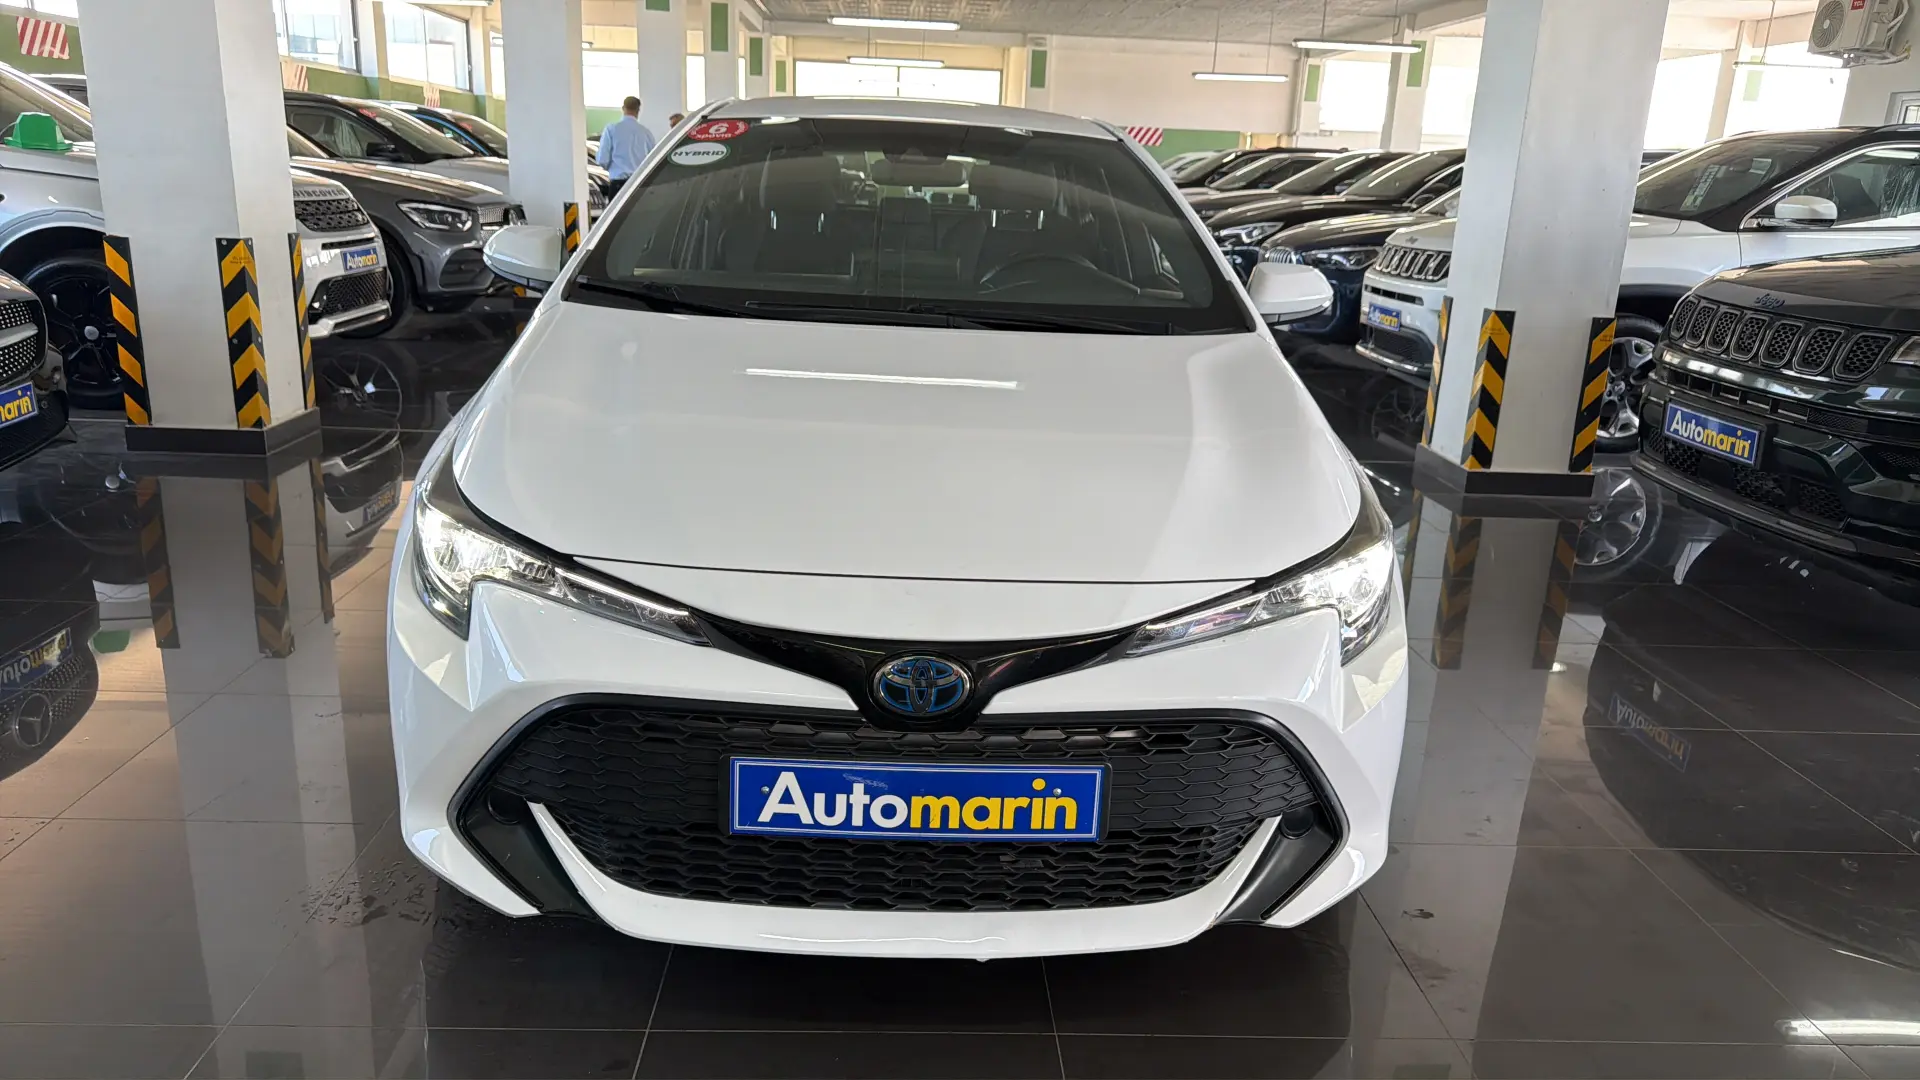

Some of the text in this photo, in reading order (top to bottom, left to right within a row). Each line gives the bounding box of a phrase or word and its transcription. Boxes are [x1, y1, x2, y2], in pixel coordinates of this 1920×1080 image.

[709, 122, 729, 134] 6
[346, 249, 377, 269] Automarin
[1670, 410, 1751, 458] Automarin
[757, 771, 1077, 830] Automarin
